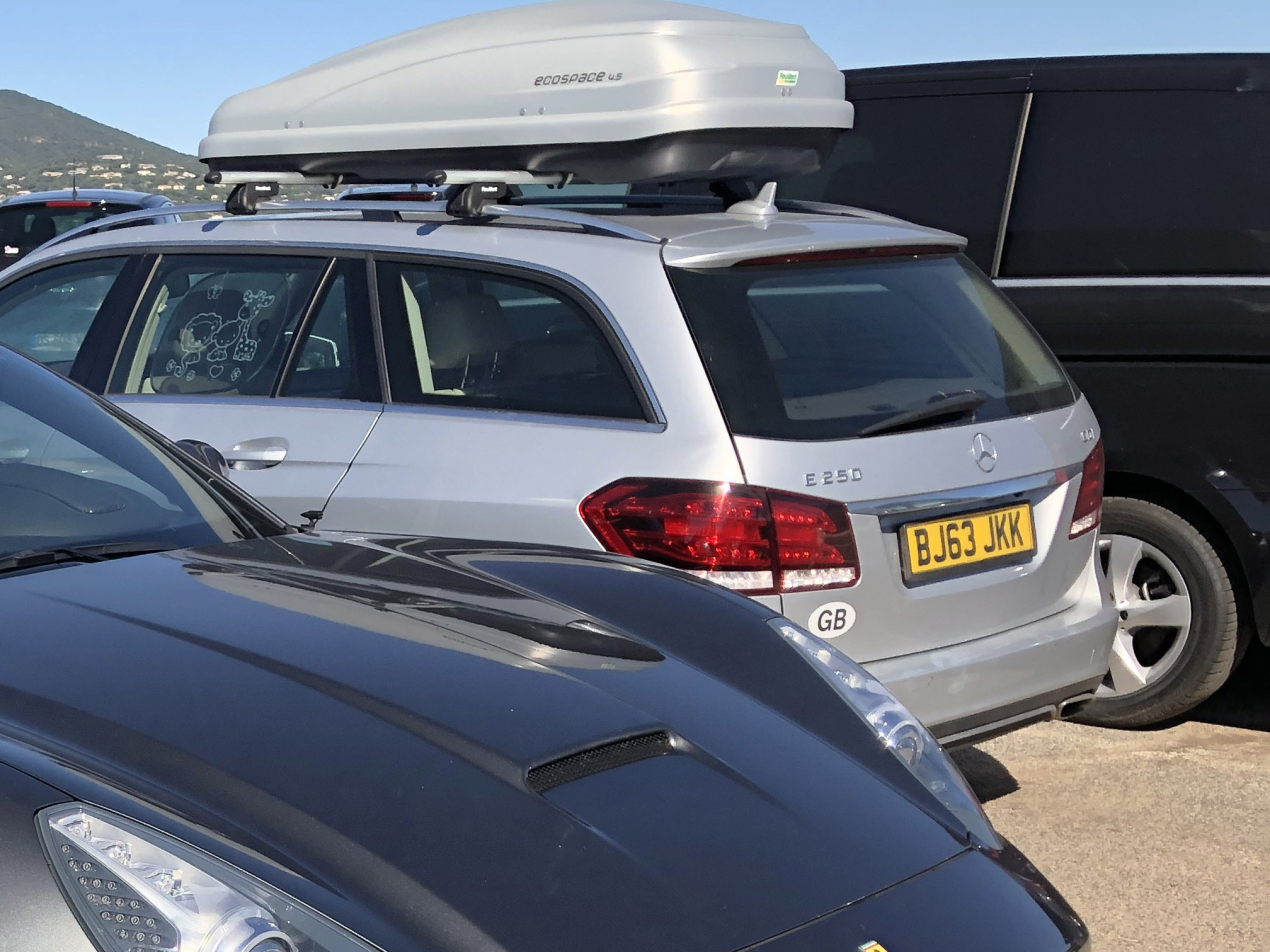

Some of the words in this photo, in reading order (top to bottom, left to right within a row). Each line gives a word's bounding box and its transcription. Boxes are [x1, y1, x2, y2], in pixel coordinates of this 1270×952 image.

[534, 71, 607, 86] ecospace
[803, 473, 817, 487] E
[821, 467, 862, 485] 250
[914, 520, 977, 567] BJ63
[983, 511, 1024, 553] JKK
[817, 608, 847, 632] GB
